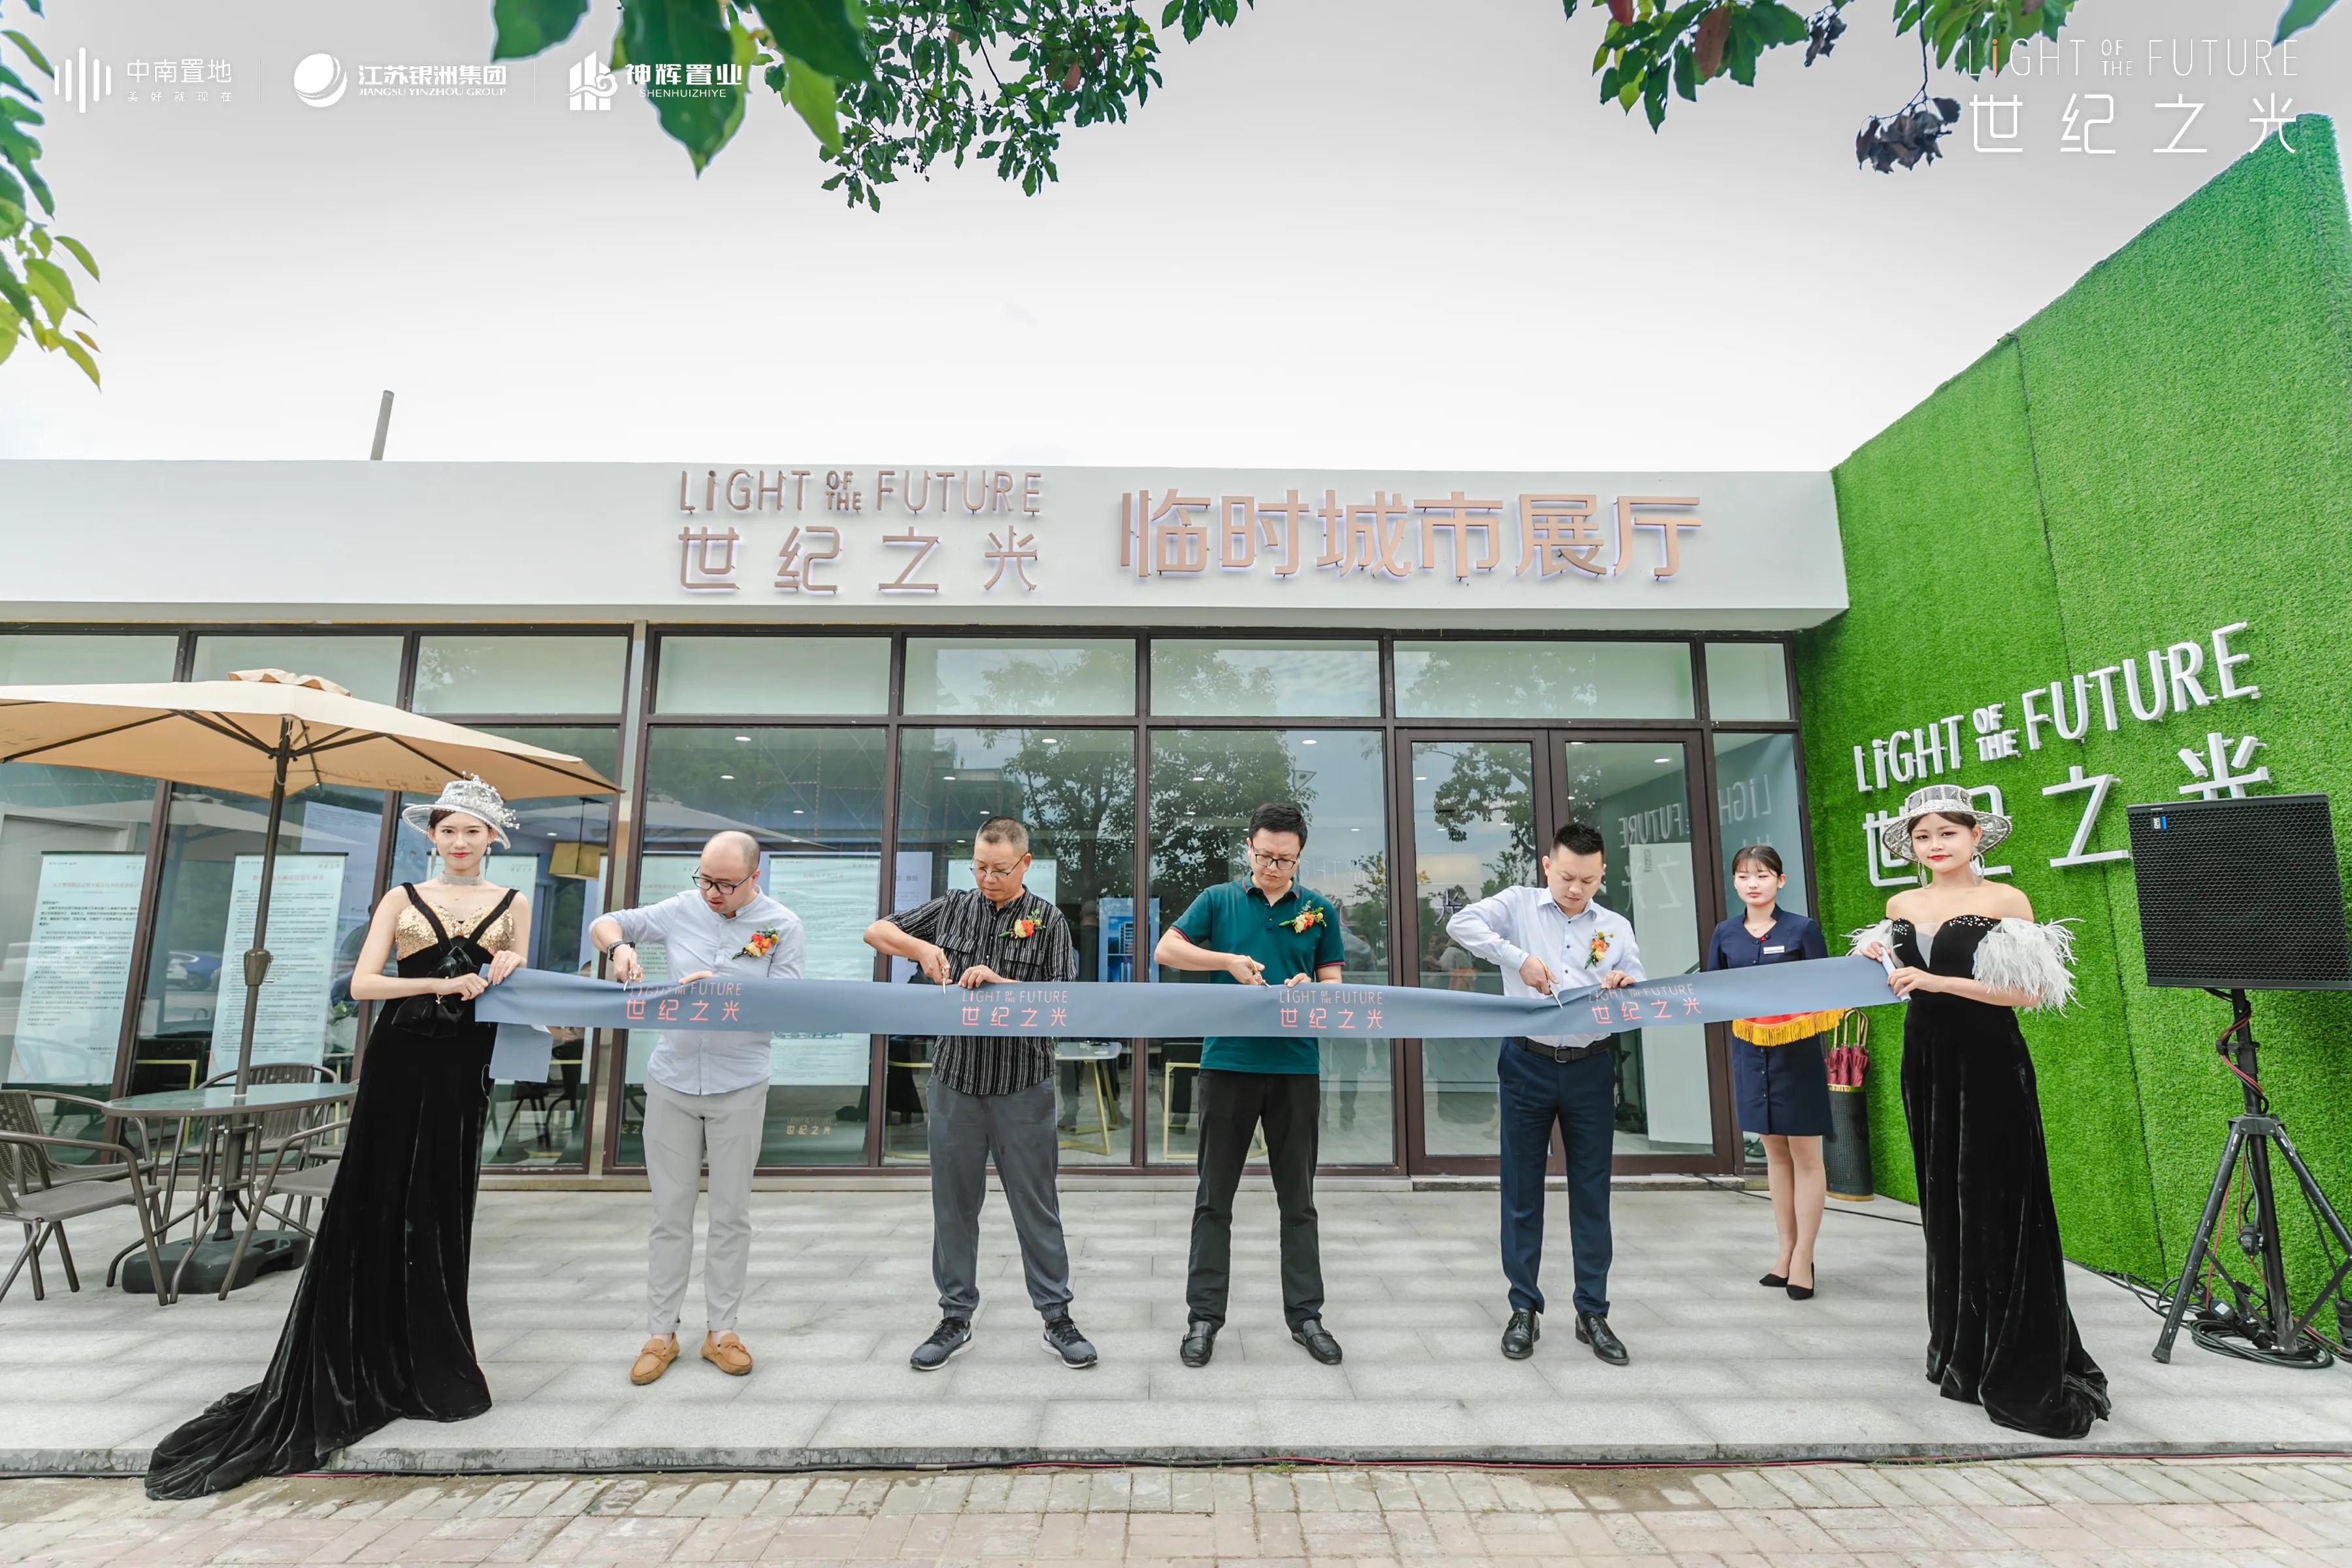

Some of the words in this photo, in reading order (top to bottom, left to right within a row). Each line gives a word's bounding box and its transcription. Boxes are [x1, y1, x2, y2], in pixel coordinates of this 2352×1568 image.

[825, 470, 854, 491] OF
[876, 469, 1042, 513] FUTURE
[825, 491, 862, 511] THE
[1120, 489, 1702, 579] 临时城市展厅
[678, 525, 1037, 591] 世纪之光
[2021, 621, 2259, 751] FUTURE
[1972, 702, 2005, 734] OF
[1976, 728, 2021, 762] THE
[691, 982, 743, 996] FUTURE
[1019, 990, 1068, 1004] FUTURE
[1335, 990, 1383, 1005] FUTURE
[1643, 983, 1695, 997] FUTURE
[627, 999, 740, 1021] 世纪之光
[962, 1006, 1067, 1027] 世纪之光
[1280, 1007, 1383, 1029] 世纪之光
[1591, 997, 1702, 1025] 世纪之光
